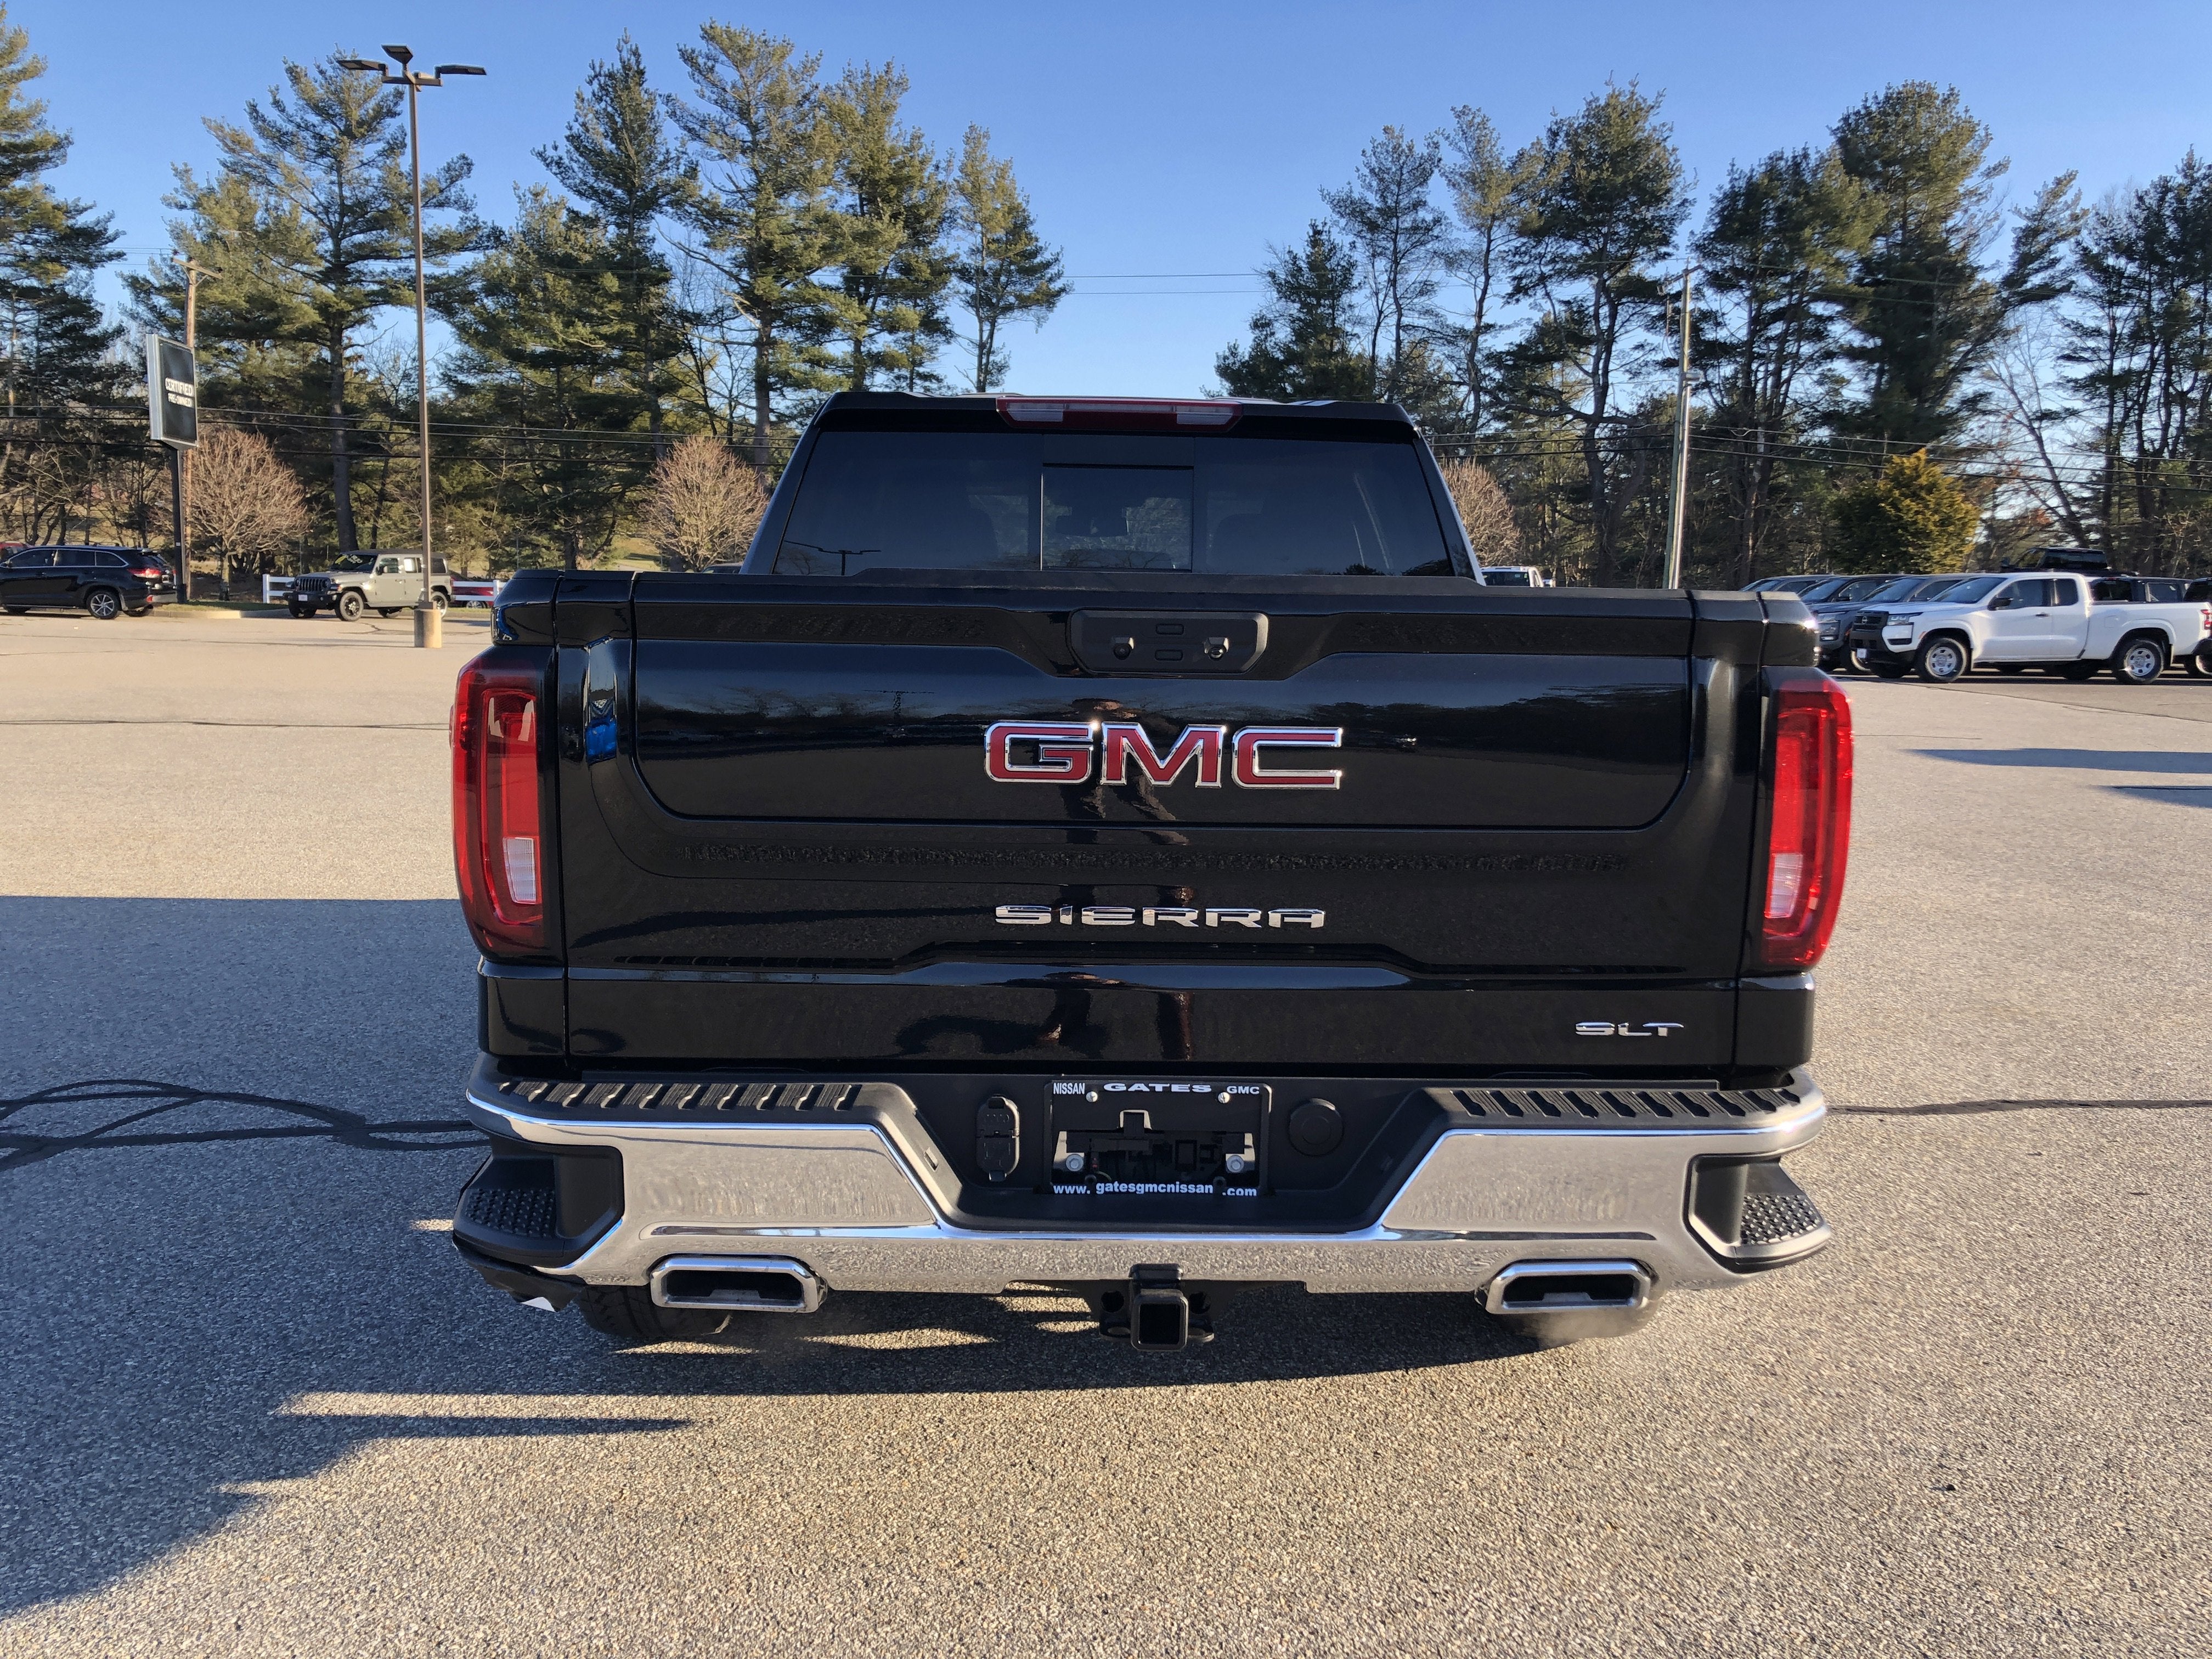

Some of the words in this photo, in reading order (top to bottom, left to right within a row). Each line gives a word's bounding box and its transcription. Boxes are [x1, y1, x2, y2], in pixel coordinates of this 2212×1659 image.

[165, 377, 194, 397] CERTIFIED
[984, 720, 1342, 789] GMC
[995, 905, 1325, 928] SIERRA
[1576, 1022, 1684, 1036] SLT
[1053, 1082, 1085, 1094] NISSAN
[1104, 1083, 1212, 1093] GATES
[1227, 1086, 1260, 1094] GMC
[1053, 1185, 1091, 1194] www.
[1096, 1181, 1213, 1194] gatesgmcnissan
